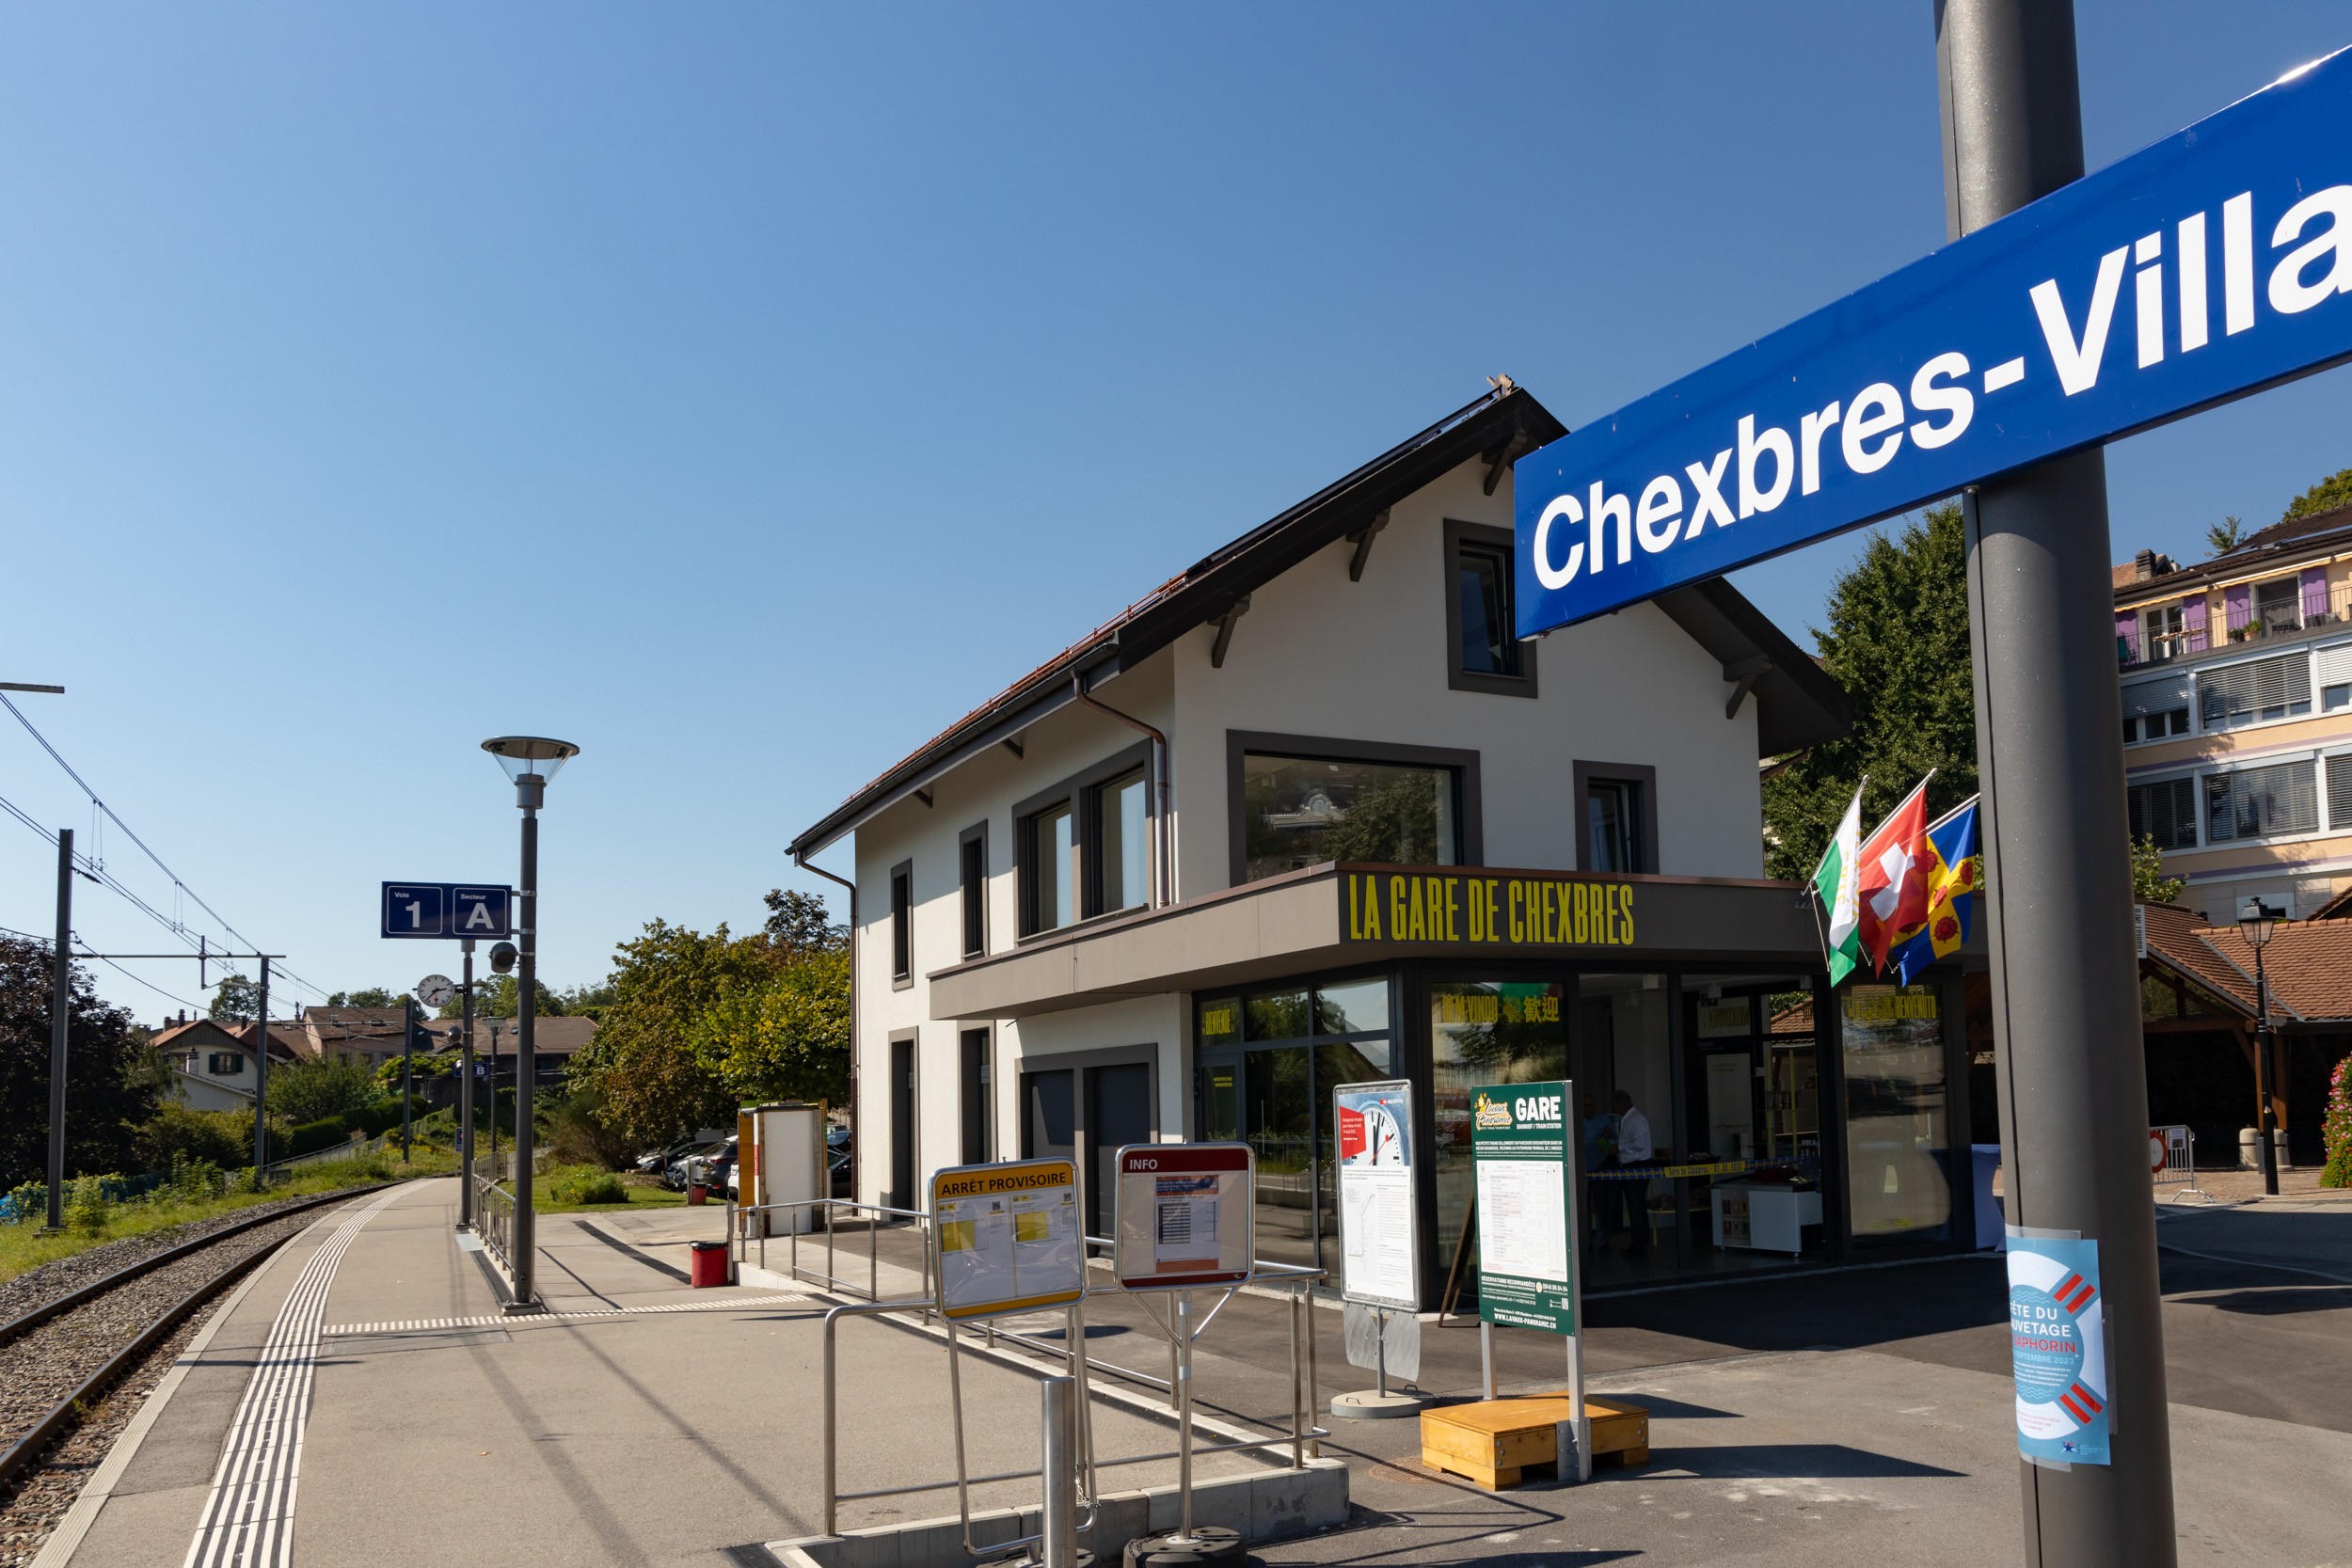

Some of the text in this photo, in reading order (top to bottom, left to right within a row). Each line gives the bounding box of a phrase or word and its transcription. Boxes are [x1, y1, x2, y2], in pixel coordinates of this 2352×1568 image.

[405, 901, 421, 928] 1
[465, 903, 494, 929] A
[1349, 874, 1634, 945] LA GARE DE CHEXBRES
[1896, 995, 1937, 1019] BENVENUTO
[1516, 1096, 1561, 1121] GARE
[1129, 1159, 1158, 1171] INFO
[942, 1172, 1066, 1196] ARRÊT PROVISOIRE
[1494, 1313, 1556, 1329] WWW.LAVAUX-PANORAMIC.CH
[2036, 1307, 2057, 1320] DU
